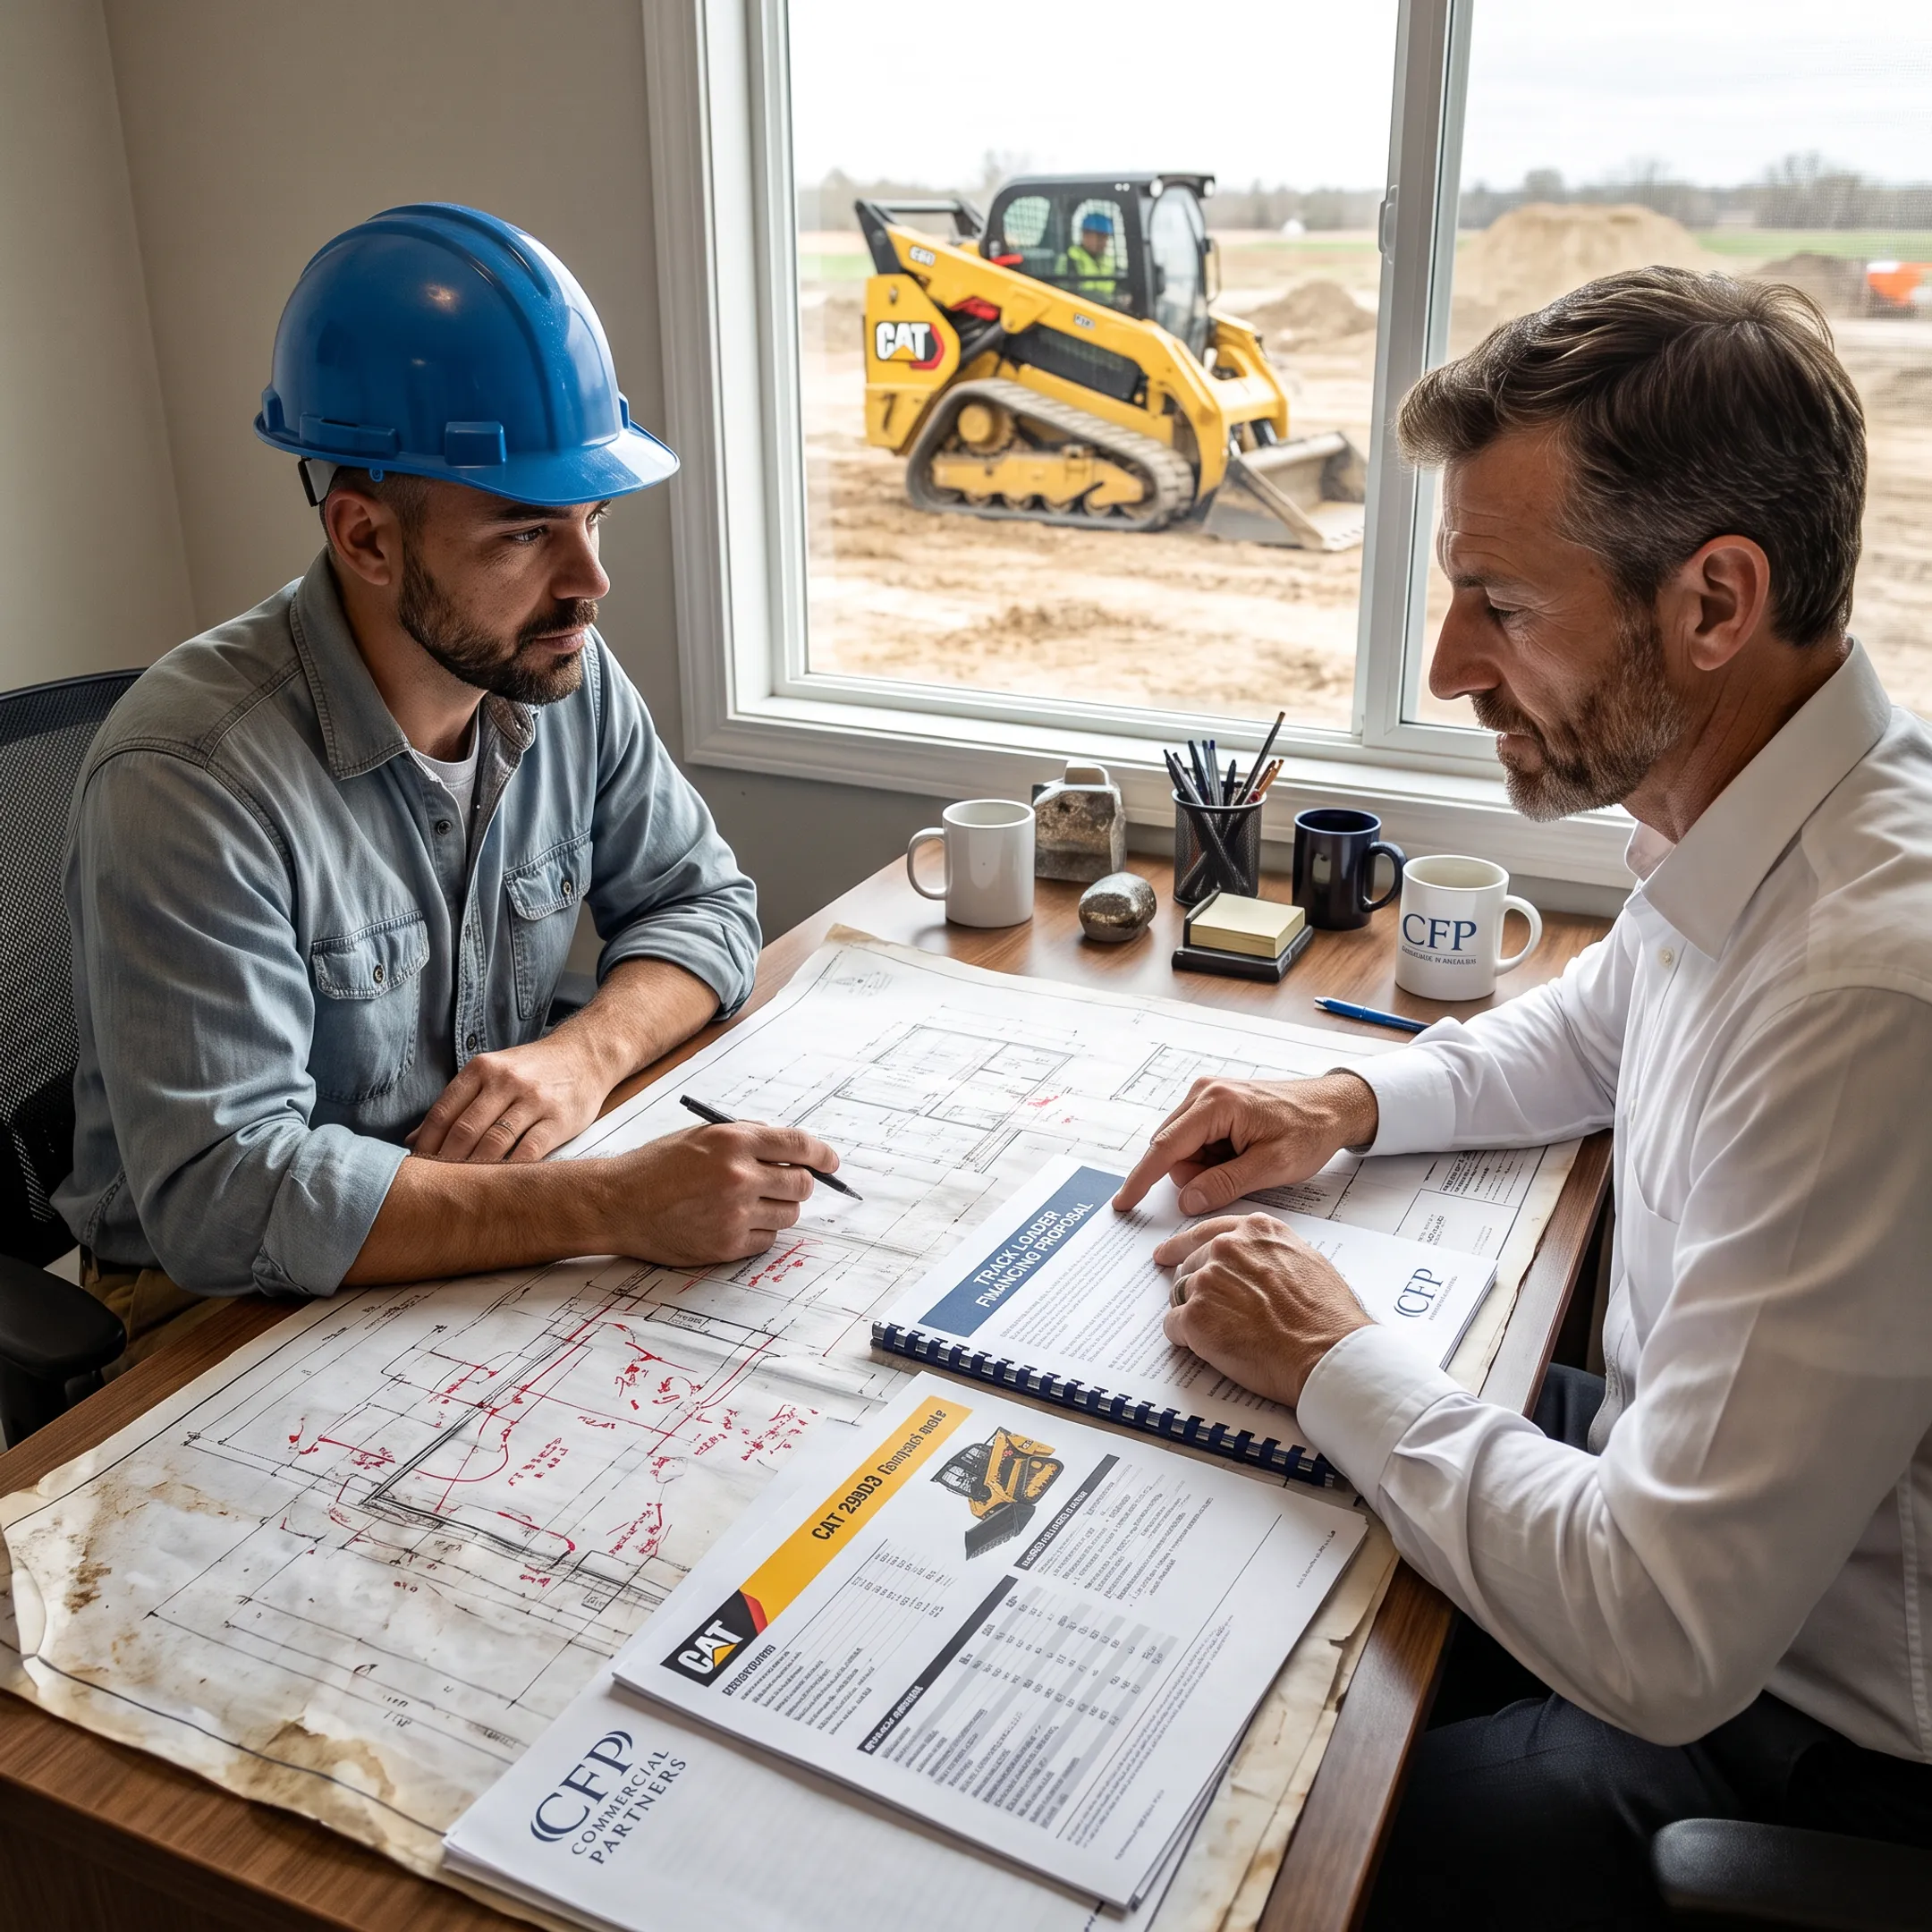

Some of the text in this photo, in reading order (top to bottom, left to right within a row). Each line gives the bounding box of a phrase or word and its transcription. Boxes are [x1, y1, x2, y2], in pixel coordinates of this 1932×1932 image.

[876, 322, 930, 361] CAT
[1402, 913, 1477, 952] CFP
[973, 1210, 1062, 1285] TRACK LOADER
[1033, 1202, 1094, 1251] PROPOSAL
[1395, 1268, 1444, 1315] CFP
[811, 1512, 845, 1540] CAT
[677, 1619, 743, 1674] CAT
[534, 1735, 633, 1837] CFP
[572, 1751, 669, 1855] COMMERCIAL
[589, 1758, 687, 1864] PARTNERS
